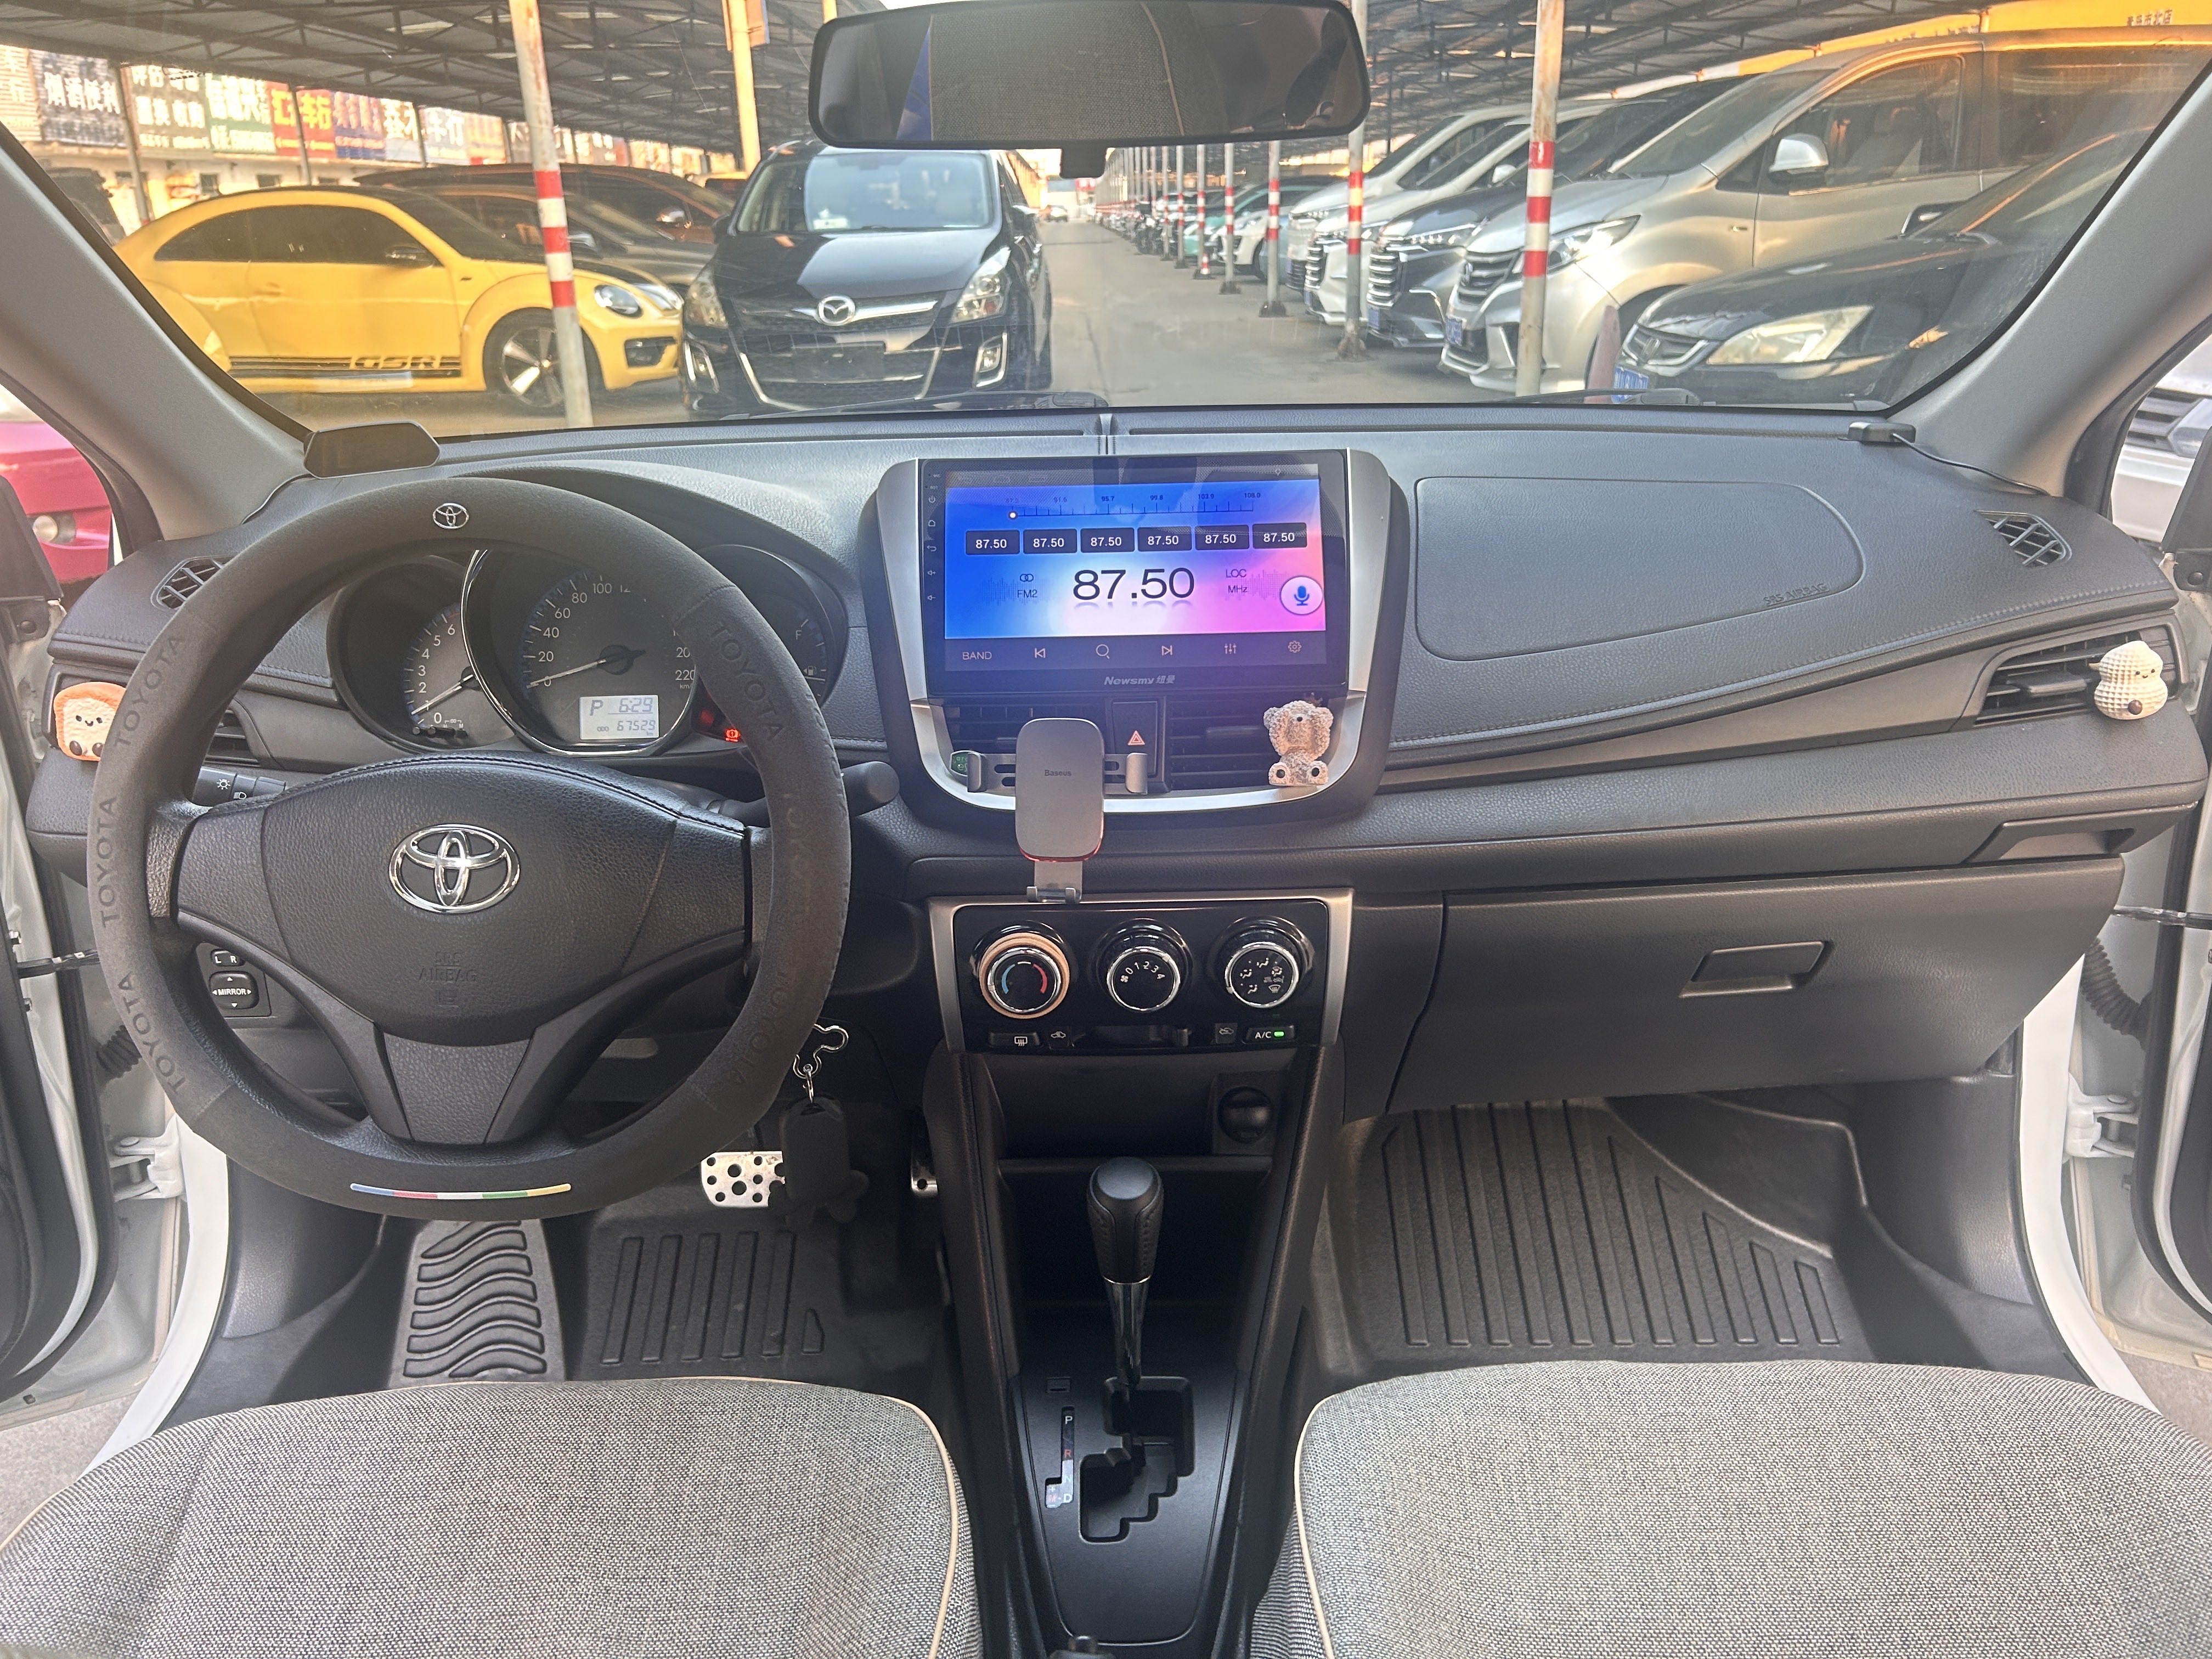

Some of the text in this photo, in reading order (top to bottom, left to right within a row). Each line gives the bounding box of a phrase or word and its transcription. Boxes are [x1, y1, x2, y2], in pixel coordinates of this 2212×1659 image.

[975, 532, 1295, 549] 87.50 87.50 87.50 87.50 87.50 87.50
[1225, 568, 1247, 578] LOC
[593, 583, 612, 594] 100
[1073, 567, 1194, 600] 87.50
[1228, 585, 1248, 593] MHz
[572, 592, 588, 603] 80
[1017, 589, 1038, 599] FM2
[1763, 583, 1827, 605] SRS AIRBAG
[555, 608, 571, 619] 60
[448, 624, 455, 635] 6
[543, 627, 560, 638] 40
[796, 630, 802, 640] F
[433, 635, 441, 646] 5
[421, 648, 430, 659] 4
[538, 651, 554, 662] 20
[676, 647, 691, 658] 20
[962, 651, 992, 660] BAND
[418, 665, 426, 676] 3
[709, 620, 785, 742] TOYOTA
[1104, 675, 1176, 686] Newsmy 纽曼
[113, 634, 185, 748] TOYOTA
[419, 682, 427, 693] 2
[590, 697, 653, 716] P 6:29
[434, 712, 442, 724] 0
[617, 720, 656, 731] 67529
[97, 797, 120, 929] TOYOTA
[215, 955, 238, 964] L R
[1143, 961, 1150, 969] 2
[1150, 965, 1159, 973] 3
[419, 967, 478, 983] AIRBAG
[218, 988, 247, 996] MIRROR
[117, 970, 187, 1095] TOYOTA
[1255, 1031, 1272, 1039] A/C
[1065, 1415, 1073, 1425] P
[1064, 1449, 1072, 1458] R
[1063, 1493, 1073, 1503] D
